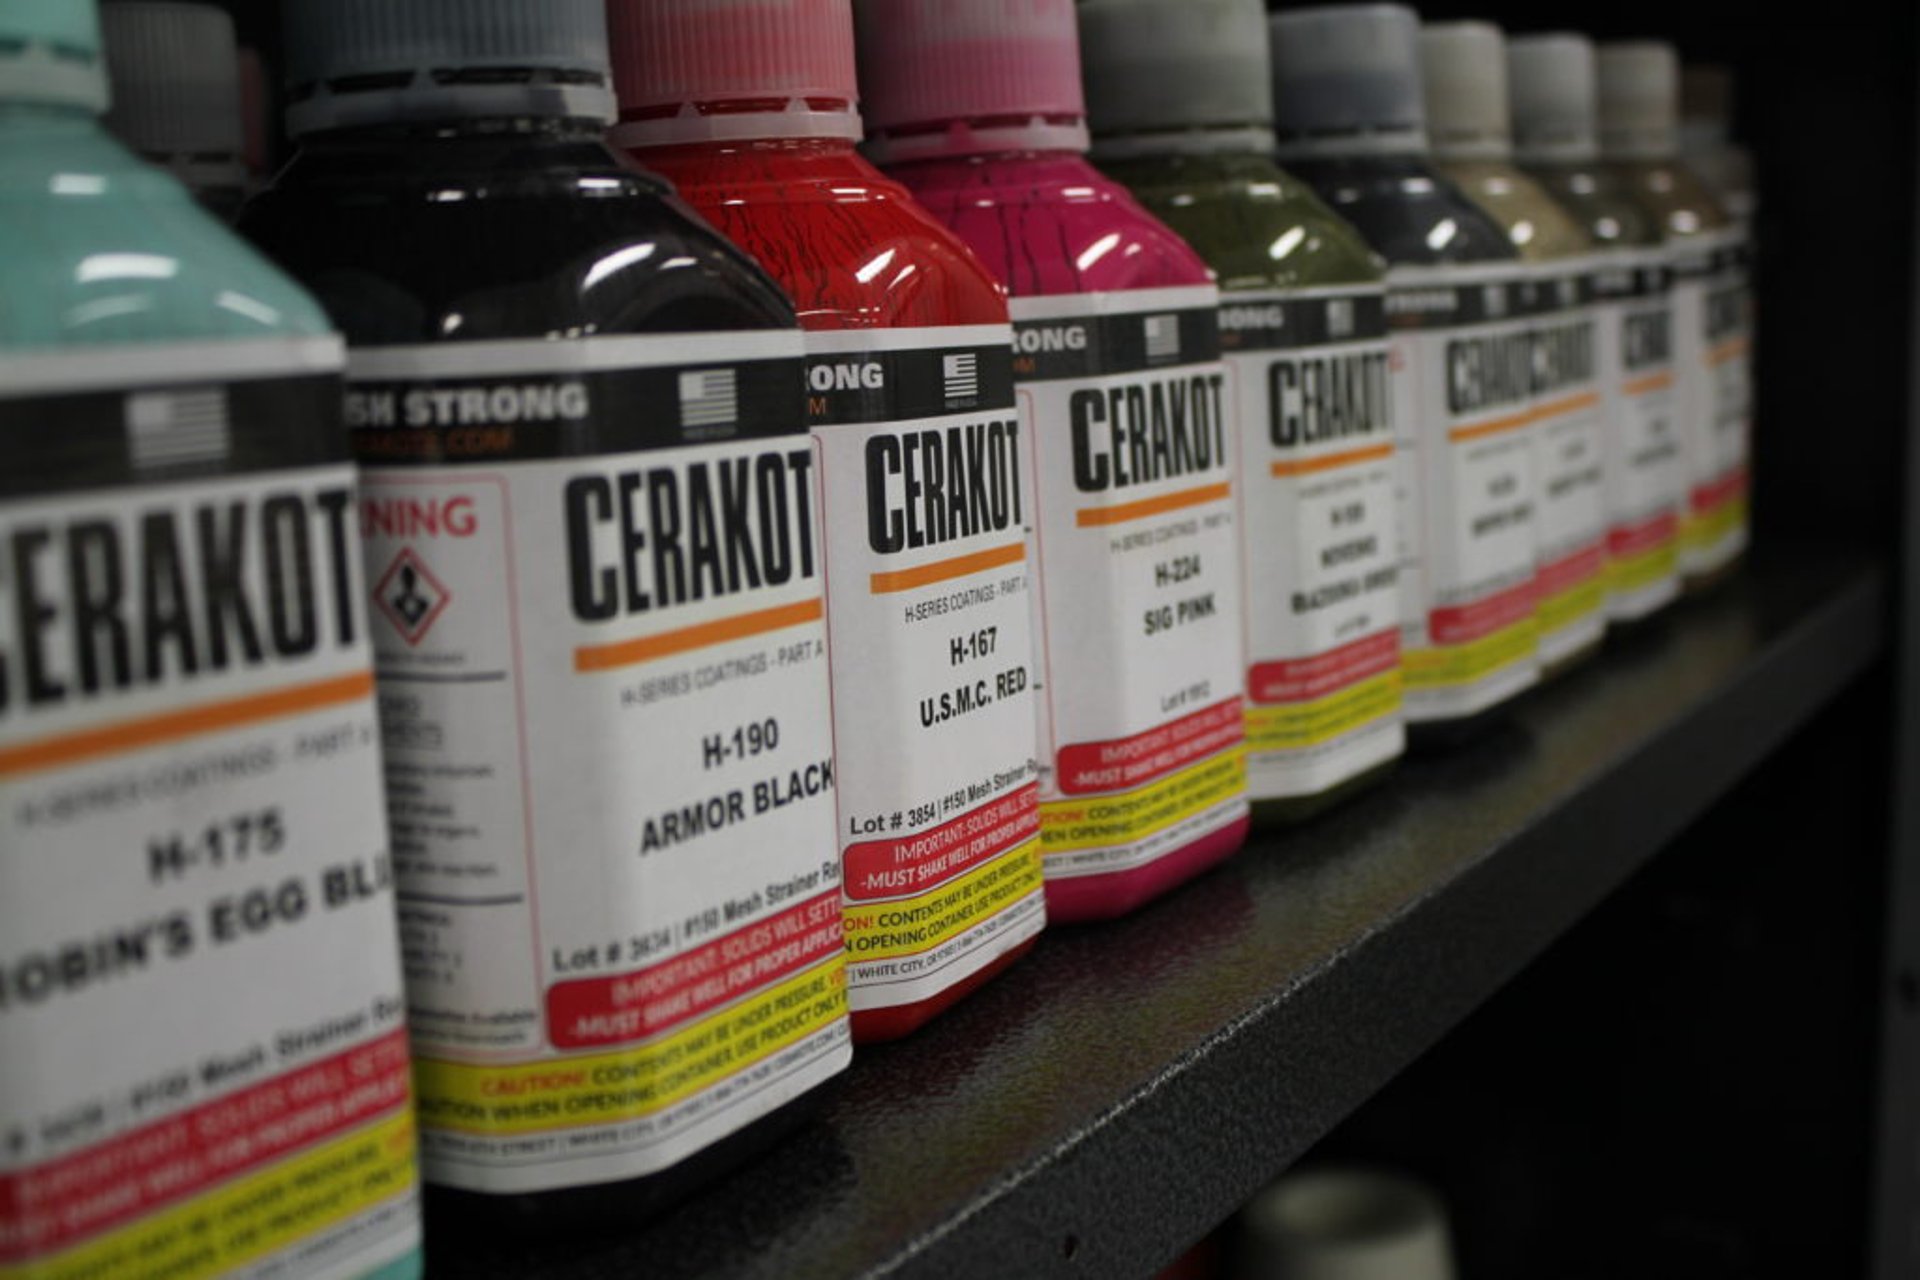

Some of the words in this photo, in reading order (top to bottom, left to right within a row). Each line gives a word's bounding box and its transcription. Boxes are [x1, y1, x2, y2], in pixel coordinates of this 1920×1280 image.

[403, 383, 590, 427] STRONG
[865, 420, 1021, 555] CERAKOT
[564, 451, 814, 623] CERAKOT
[1154, 553, 1201, 588] H-224
[0, 490, 355, 720] ERAKOT
[905, 596, 949, 623] H-SERIES
[950, 584, 995, 611] COATINGS
[1144, 604, 1173, 636] SIG
[1177, 591, 1216, 626] PINK
[694, 651, 767, 692] COATINGS
[778, 643, 812, 668] PART
[950, 625, 998, 666] H-167
[920, 680, 992, 728] U.S.M.C.
[997, 665, 1026, 700] RED
[702, 717, 780, 770] H-190
[639, 790, 746, 856] ARMOR
[753, 757, 834, 816] BLACK
[850, 814, 885, 835] Lot
[890, 812, 902, 830] #
[908, 801, 935, 828] 3854
[943, 789, 966, 812] #150
[967, 779, 993, 803] Mesh
[993, 765, 1026, 792] Strainer
[146, 803, 287, 885] H-175
[894, 825, 965, 864] IMPORTANT:
[967, 808, 998, 836] SOLIDS
[860, 868, 915, 891] -MUST
[916, 854, 948, 880] SHAKE
[948, 843, 971, 868] WELL
[971, 838, 985, 857] FOR
[552, 946, 599, 972] Lot
[724, 891, 763, 921] Mesh
[765, 868, 820, 907] Strainer
[878, 897, 944, 929] CONTENTS
[944, 890, 961, 910] MAY
[962, 884, 974, 900] BE
[974, 870, 998, 895] UNDER
[720, 926, 773, 961] SOLIDS
[771, 913, 806, 943] WILL
[856, 924, 927, 953] OPENING
[642, 994, 693, 1026] SHAKE
[691, 977, 728, 1011] WELL
[727, 967, 753, 994] FOR
[753, 945, 801, 981] PROPER
[858, 961, 898, 979] WHITE
[685, 1025, 715, 1053] MAY
[716, 1017, 732, 1040] BE
[732, 1001, 771, 1034] UNDER
[564, 1085, 656, 1113] OPENING
[737, 1035, 759, 1060] USE
[760, 1009, 812, 1051] PRODUCT
